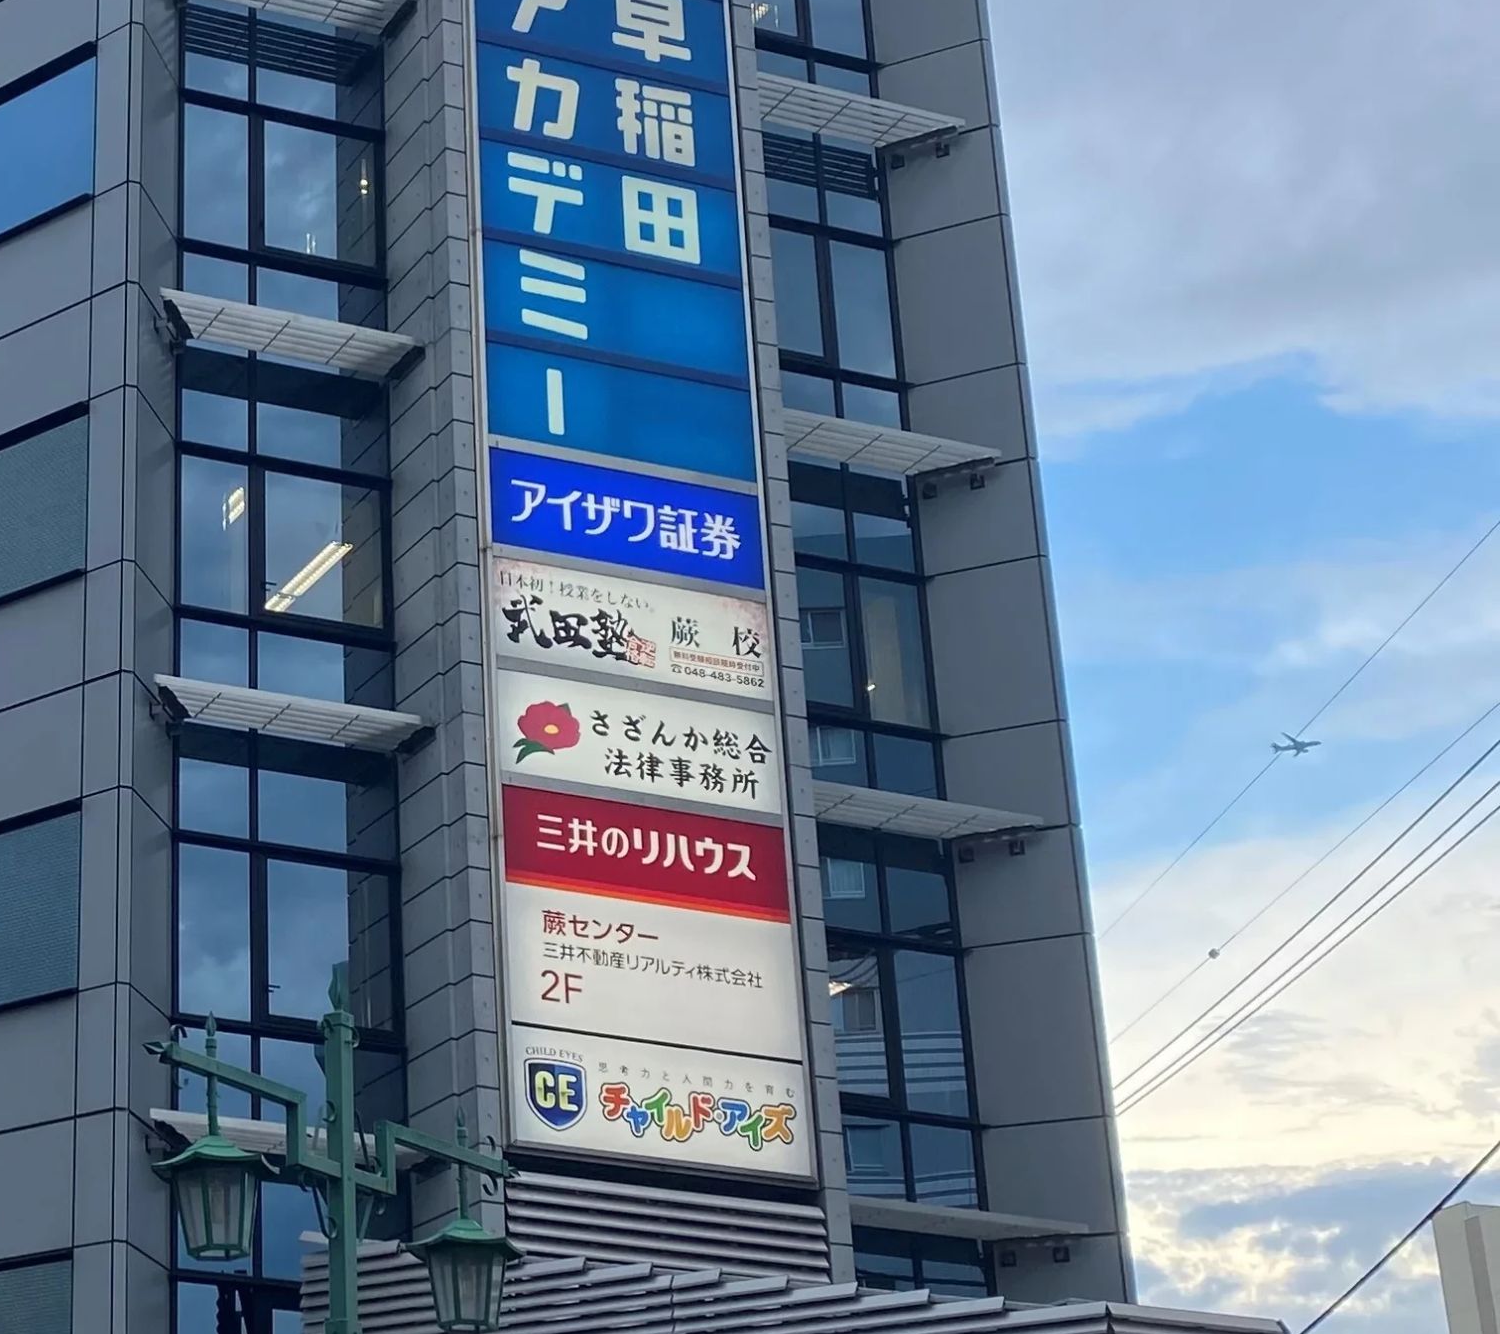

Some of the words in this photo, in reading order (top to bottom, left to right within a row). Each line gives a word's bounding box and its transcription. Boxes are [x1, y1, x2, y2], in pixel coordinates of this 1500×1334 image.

[511, 478, 741, 560] アイザワ証券
[502, 594, 637, 665] 武田塾
[589, 709, 773, 765] さざんか総合
[604, 748, 760, 800] 法律事務所
[536, 813, 756, 881] 三井のリハウス
[542, 910, 659, 944] 蕨センター
[540, 970, 583, 1005] 2F
[543, 941, 764, 989] 三井不動産リアルティ株式会社
[525, 1046, 556, 1056] CHILD
[558, 1048, 584, 1063] EYES
[534, 1070, 579, 1112] CE
[599, 1082, 797, 1151] チャイルド・アイズ
